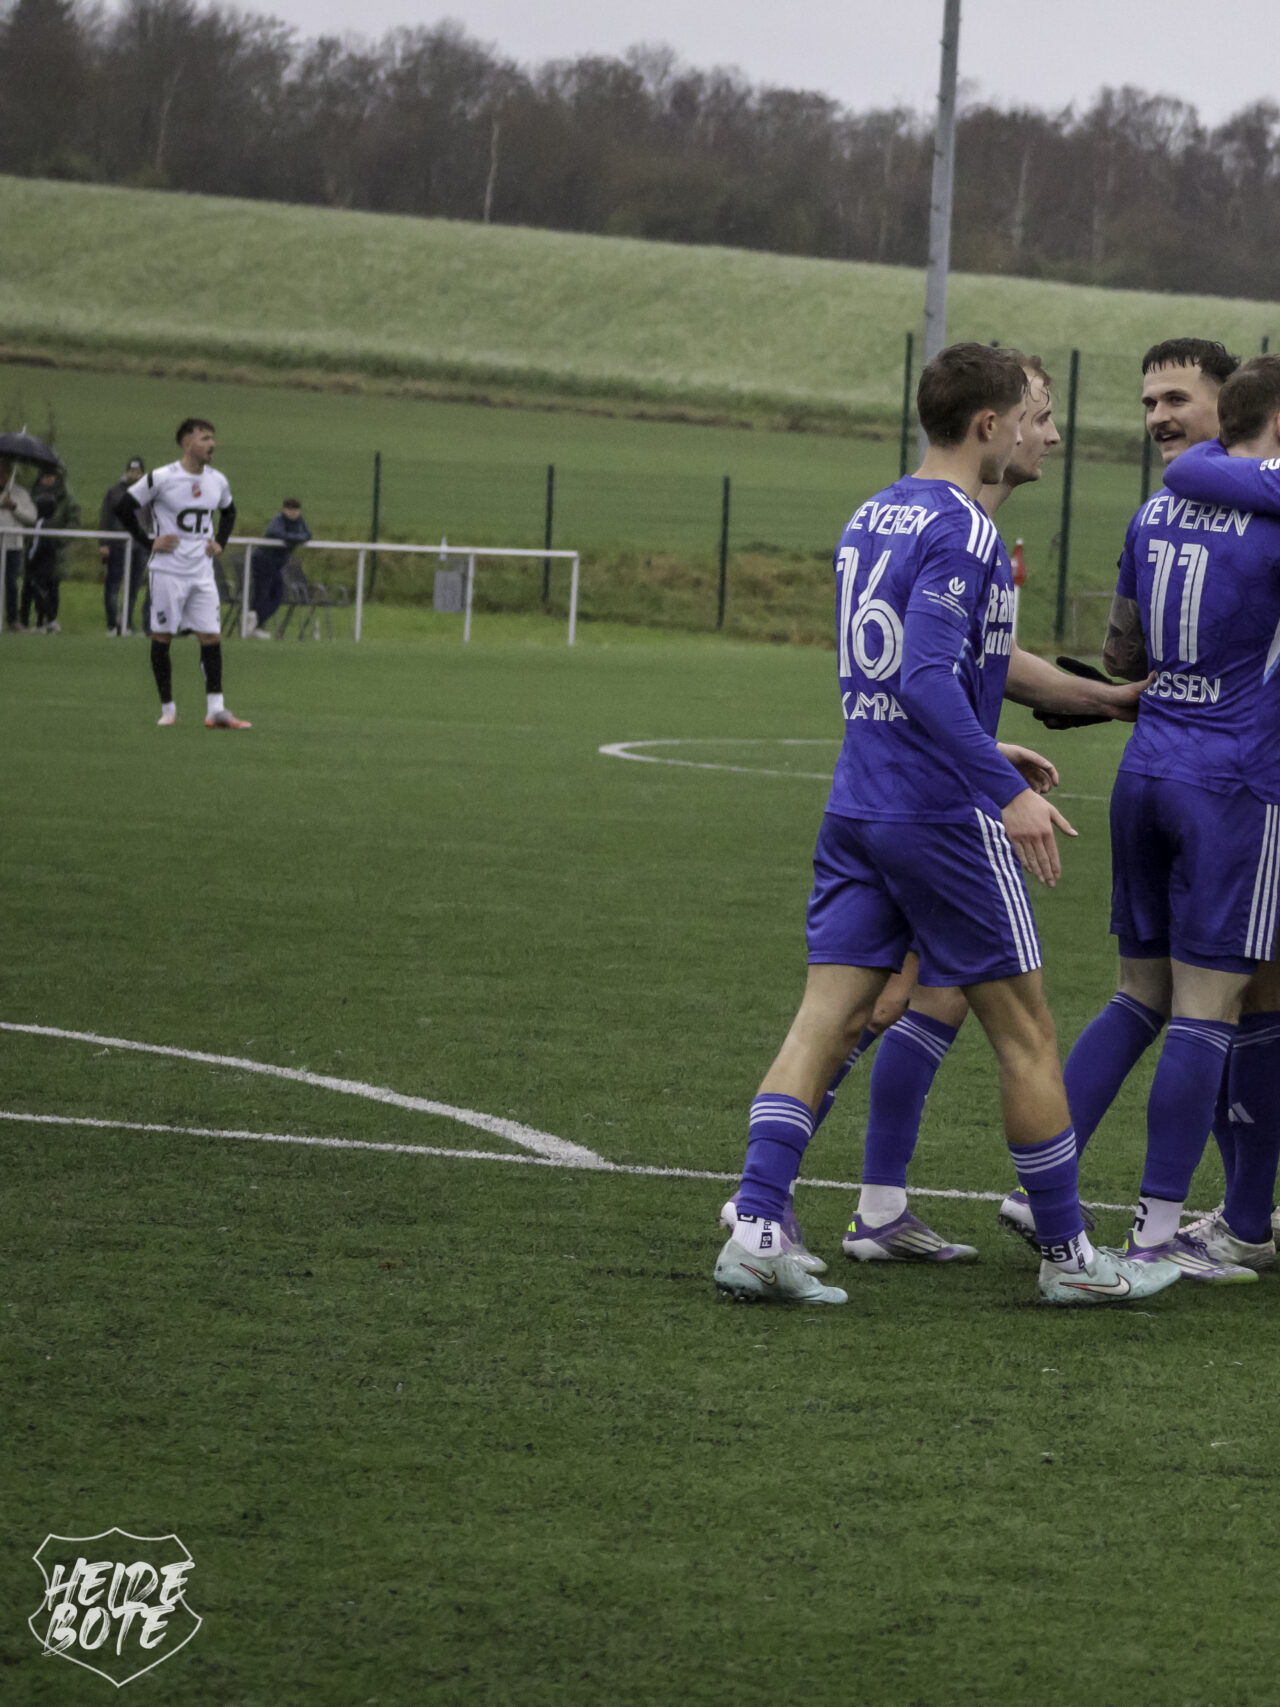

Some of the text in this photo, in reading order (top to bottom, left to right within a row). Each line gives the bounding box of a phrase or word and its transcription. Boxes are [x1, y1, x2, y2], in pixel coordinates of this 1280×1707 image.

[836, 546, 905, 682] 16
[1147, 538, 1210, 665] 11
[1144, 671, 1221, 704] OSSEN
